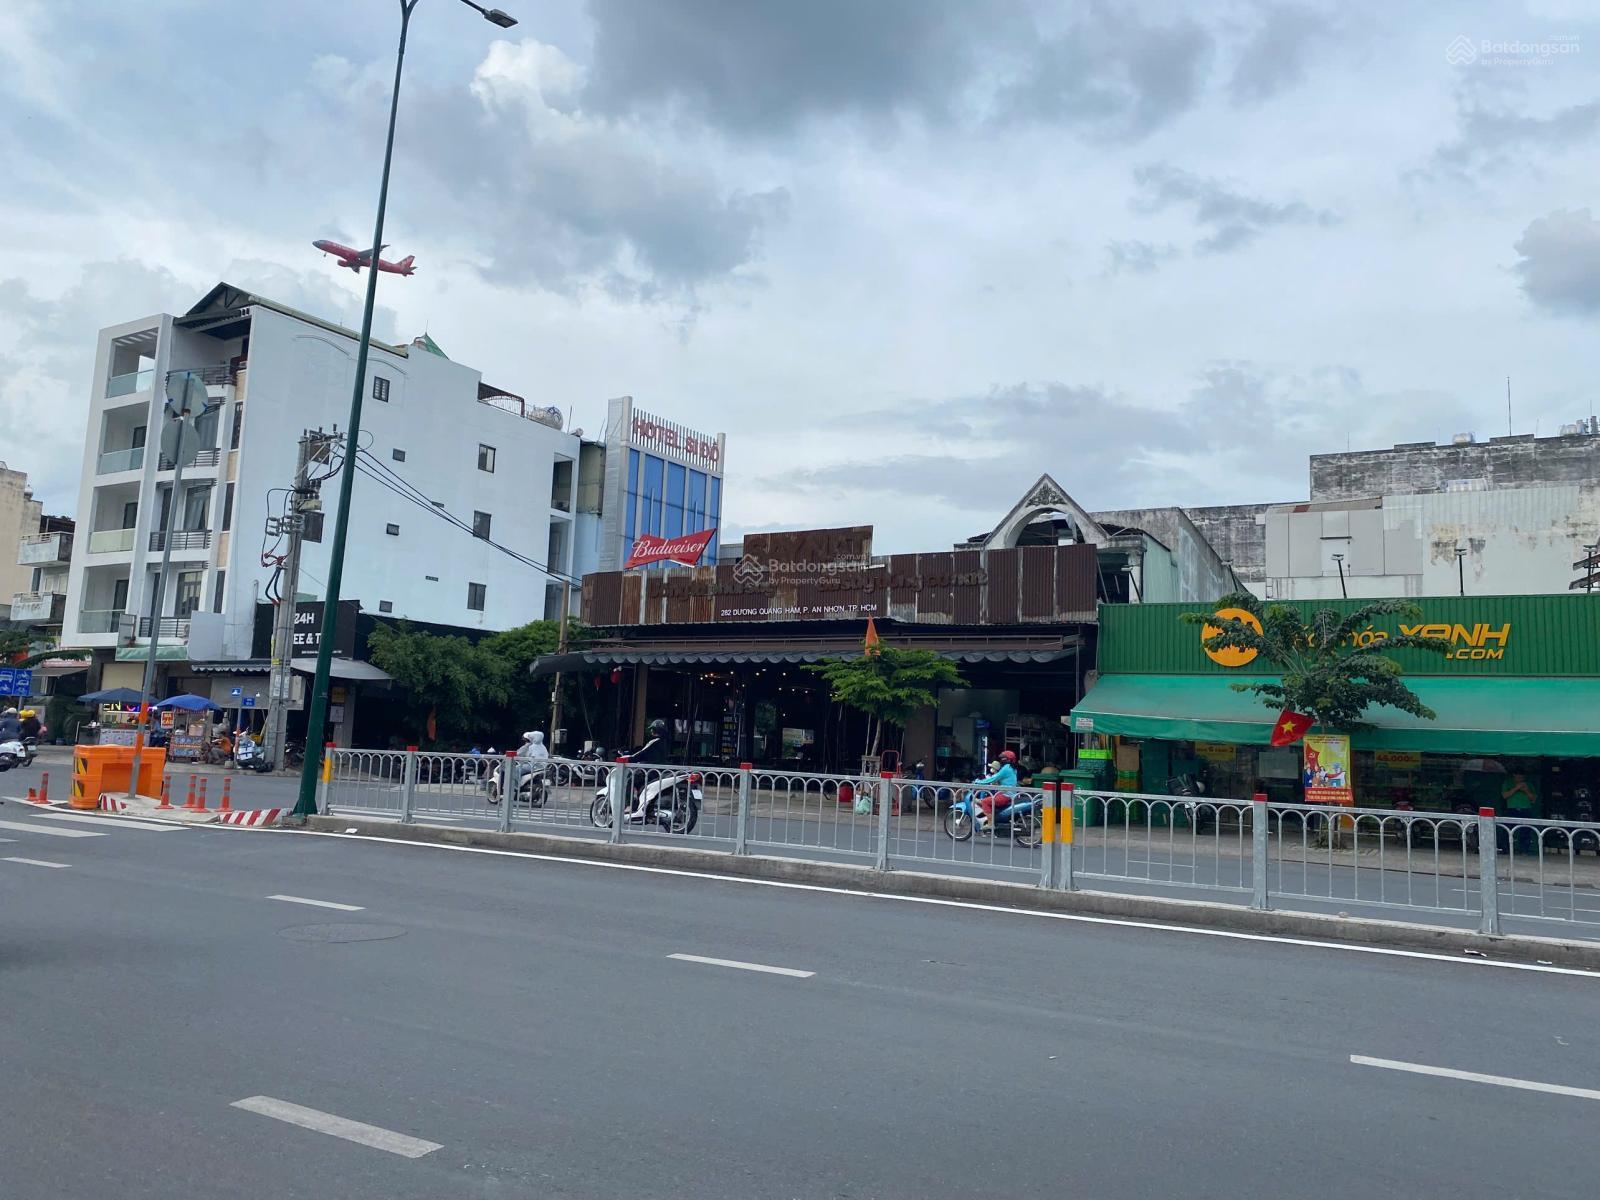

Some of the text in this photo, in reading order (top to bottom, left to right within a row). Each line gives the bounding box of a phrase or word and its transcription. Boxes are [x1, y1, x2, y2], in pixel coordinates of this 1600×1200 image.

[632, 417, 681, 450] HOTEL
[632, 539, 705, 558] Budweiser
[720, 609, 732, 617] 282
[860, 604, 877, 612] HCM
[294, 612, 315, 625] 24H
[306, 633, 314, 645] &
[1446, 648, 1505, 660] .COM
